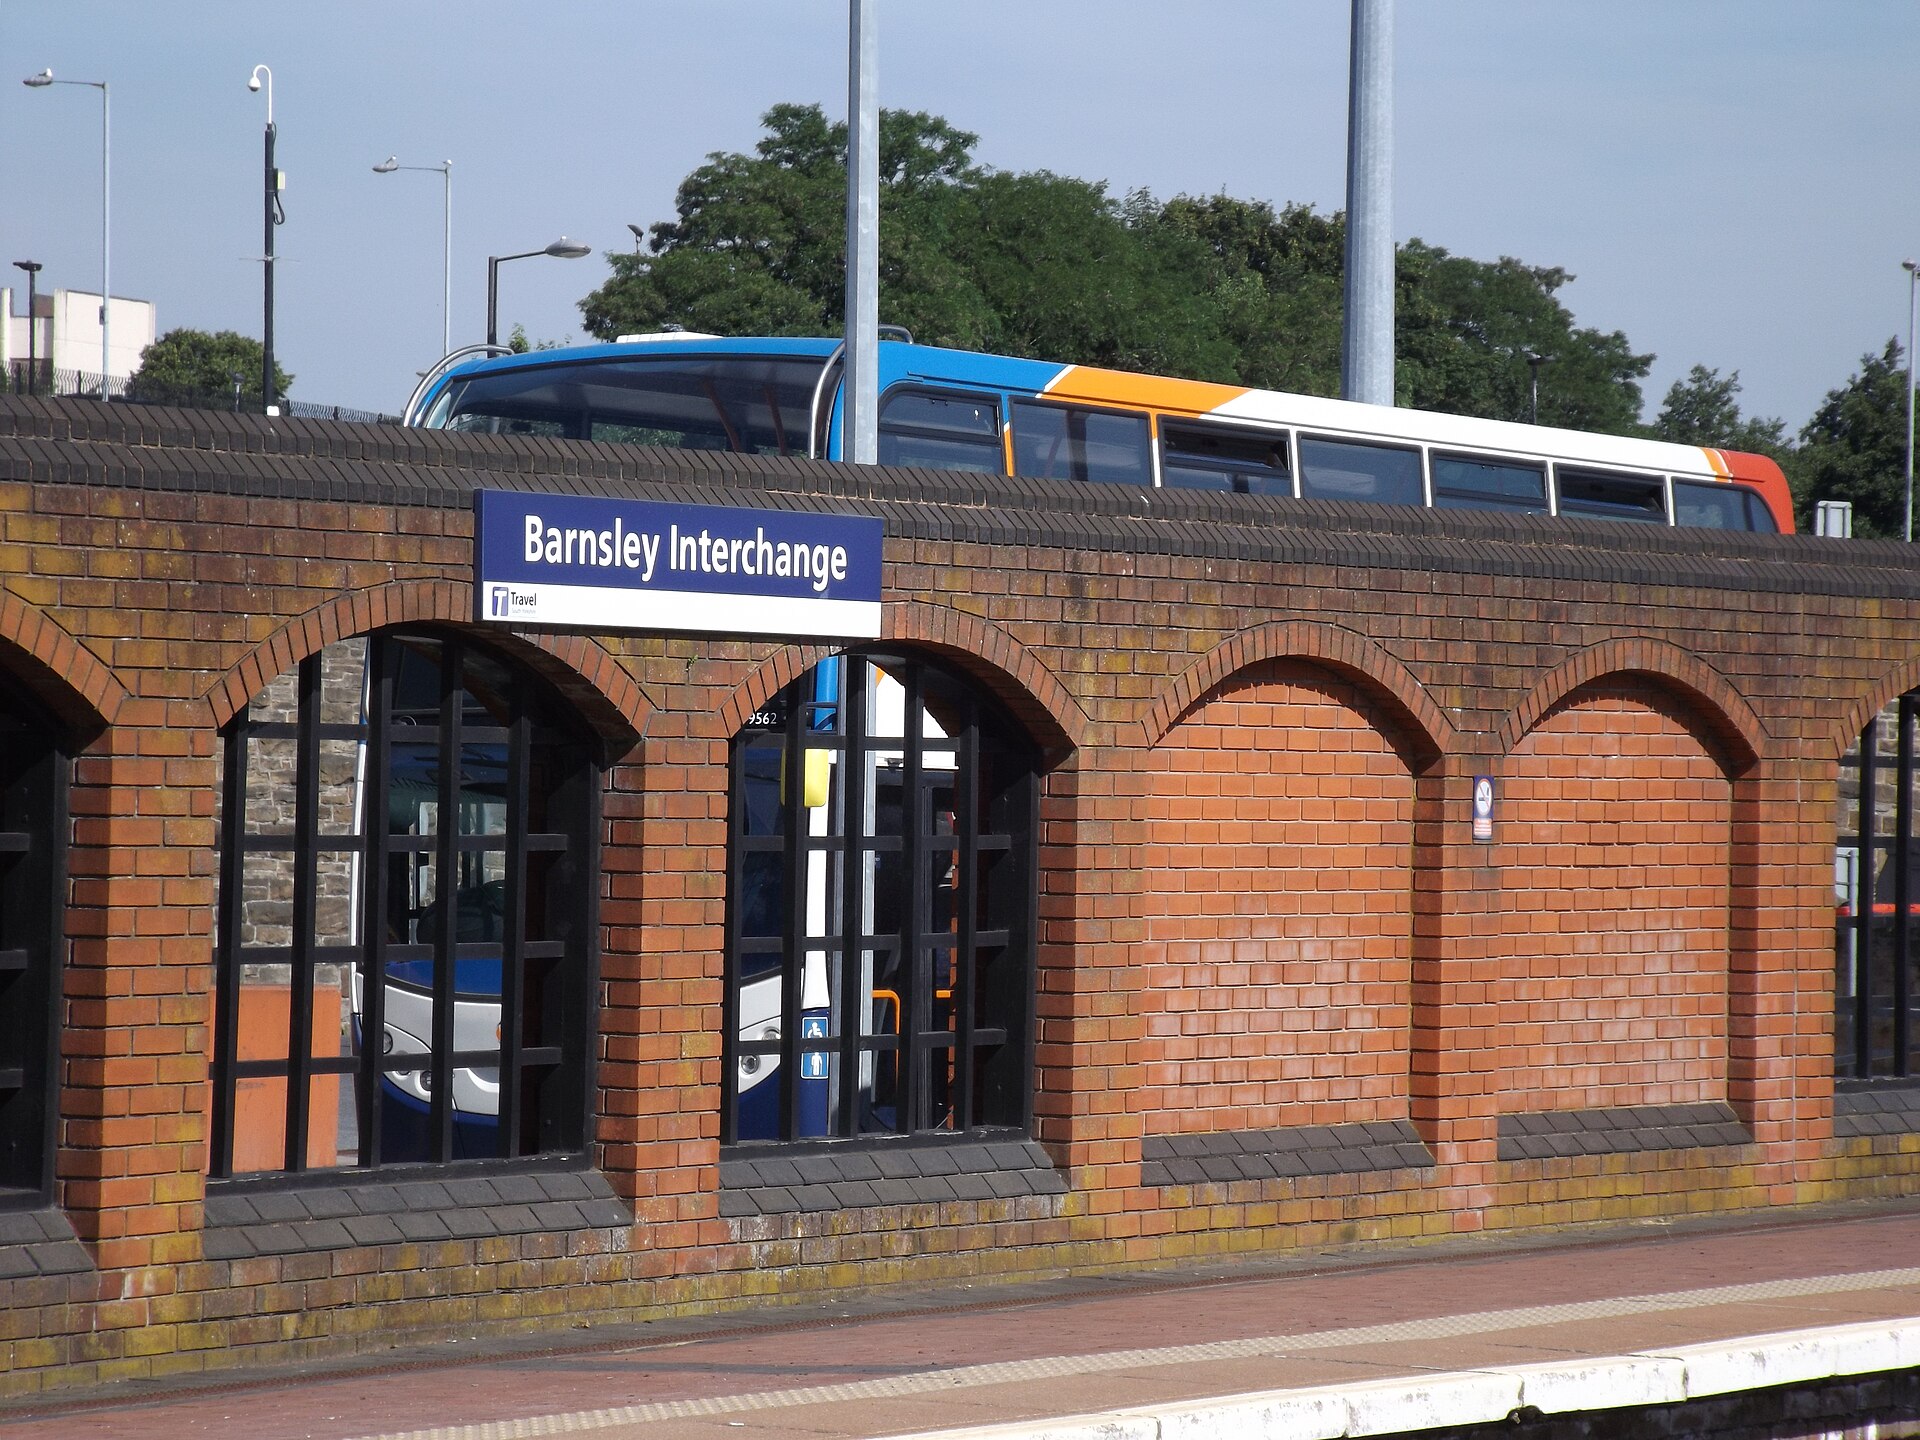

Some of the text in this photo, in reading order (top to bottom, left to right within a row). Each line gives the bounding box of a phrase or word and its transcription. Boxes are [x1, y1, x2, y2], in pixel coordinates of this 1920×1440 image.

[524, 514, 848, 592] Barnsley Interchange
[511, 591, 537, 606] Travel
